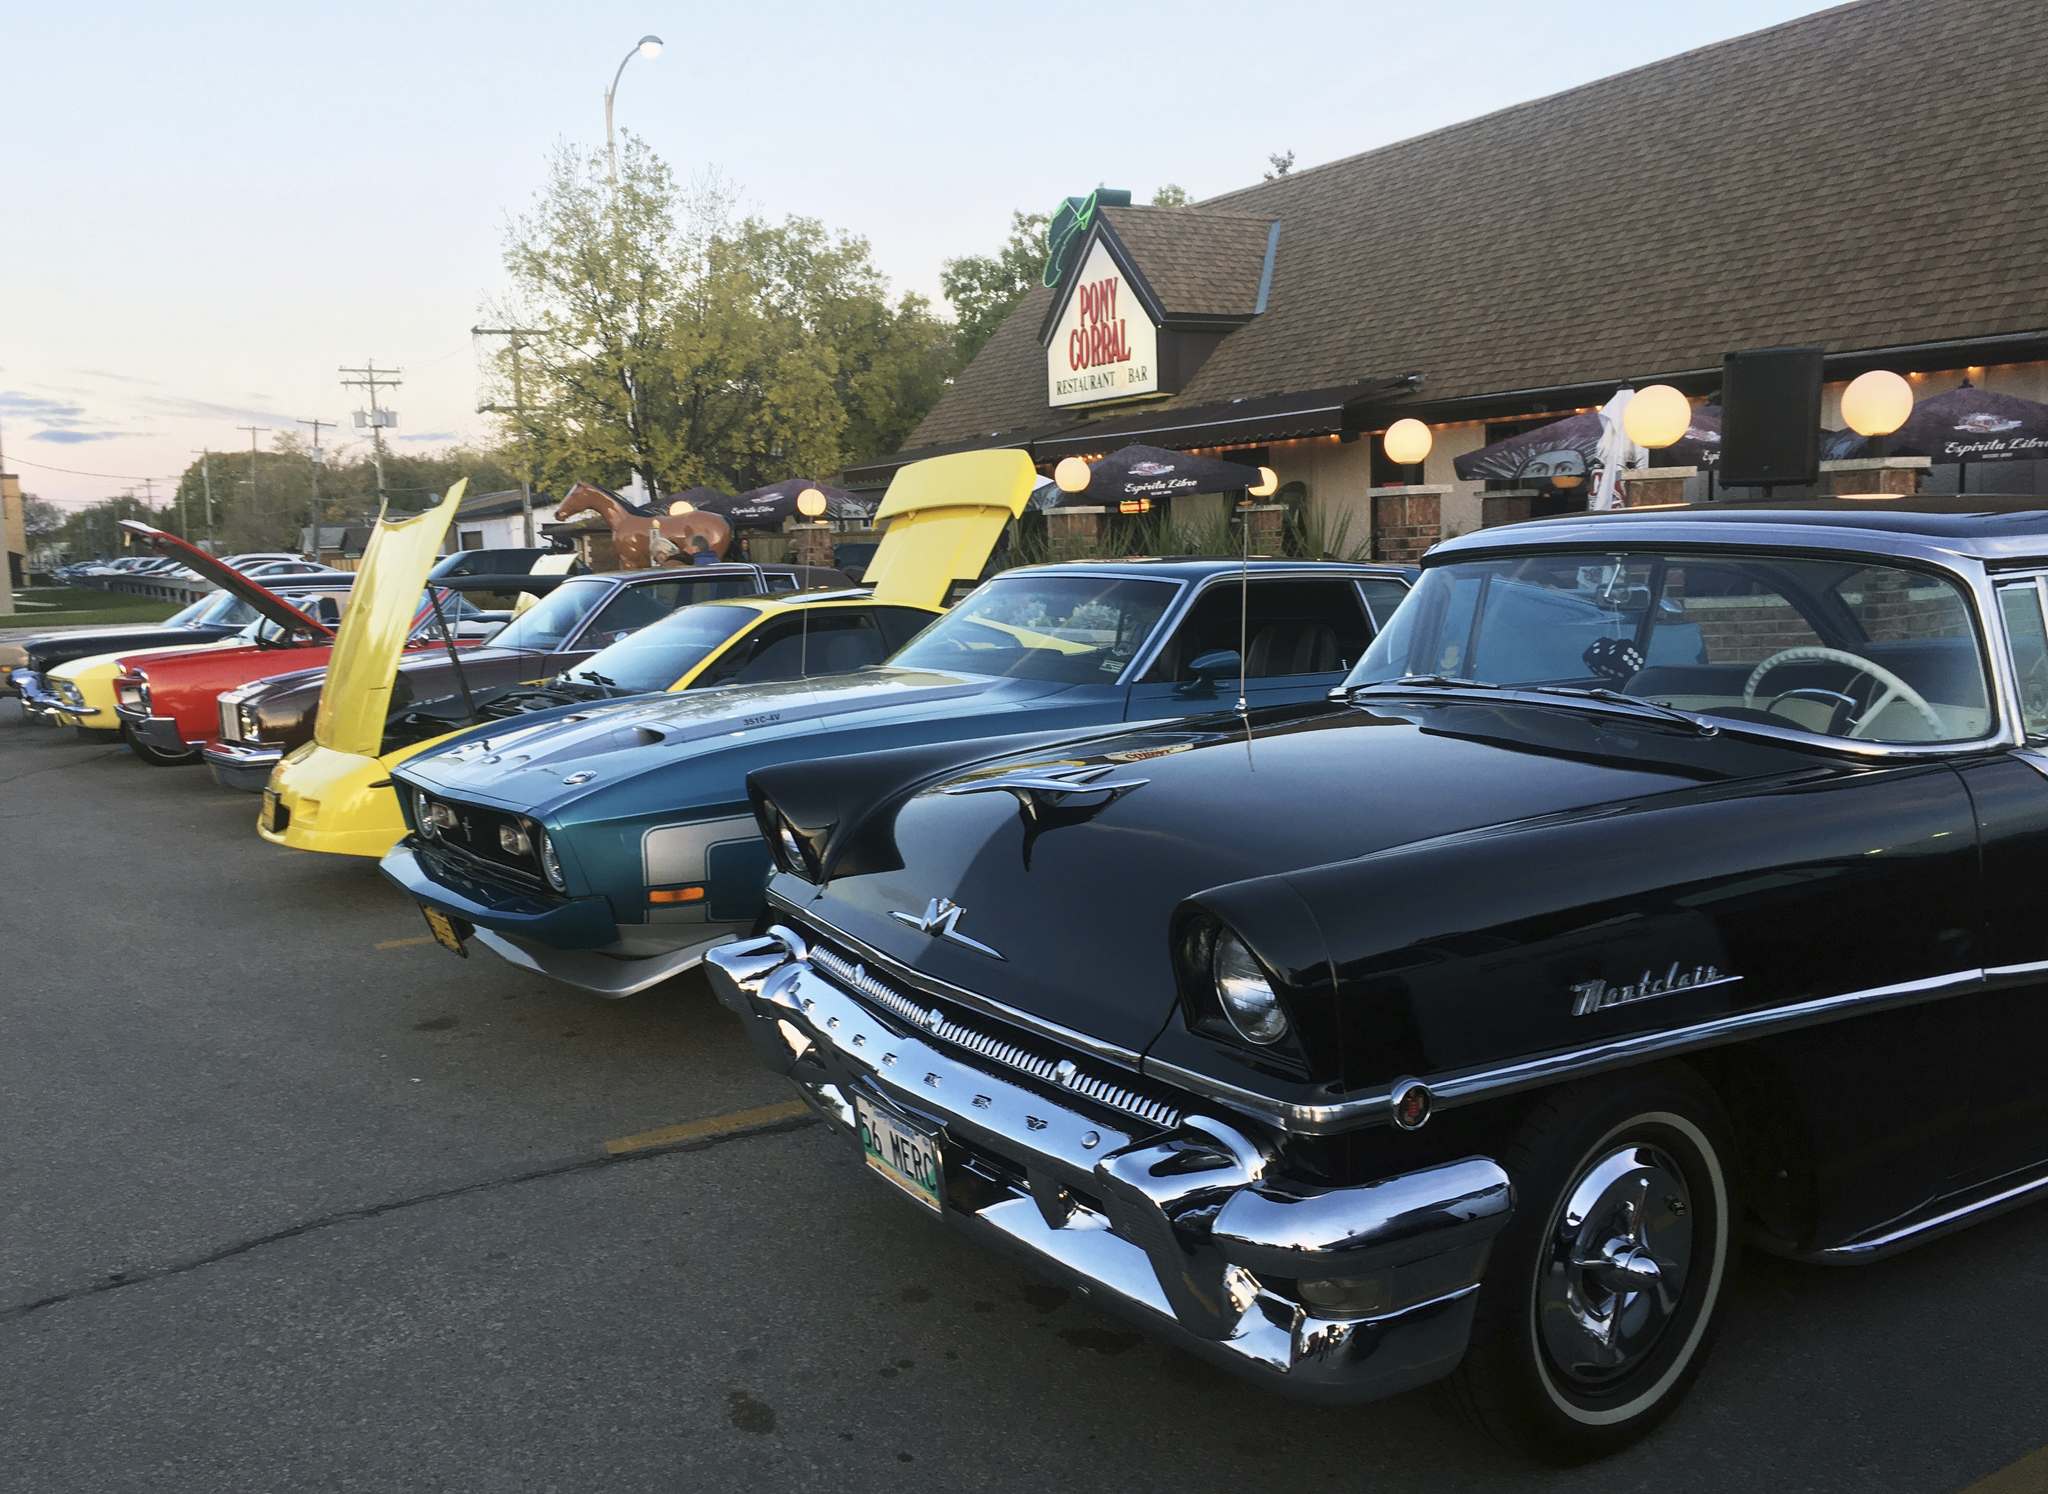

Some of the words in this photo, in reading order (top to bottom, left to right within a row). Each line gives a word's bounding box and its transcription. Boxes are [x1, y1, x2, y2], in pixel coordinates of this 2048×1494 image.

[1079, 277, 1119, 326] PONY
[1068, 319, 1131, 371] CORRAL
[1056, 371, 1115, 395] RESTAURANT
[1128, 366, 1148, 383] BAR
[889, 1129, 938, 1192] MERC
